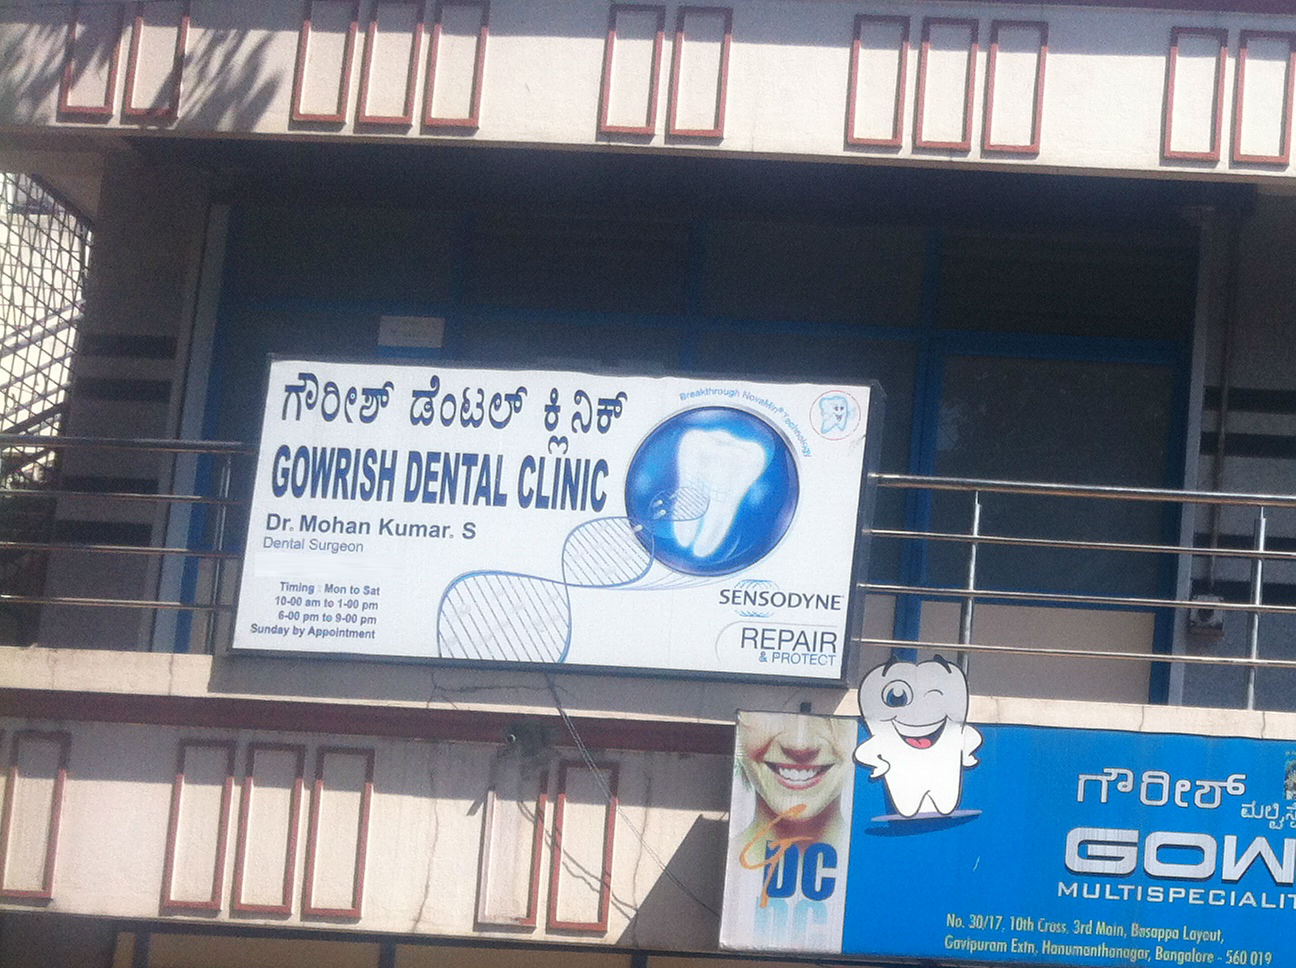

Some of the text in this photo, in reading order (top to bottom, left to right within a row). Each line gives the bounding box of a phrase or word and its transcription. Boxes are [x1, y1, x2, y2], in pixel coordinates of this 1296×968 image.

[679, 386, 741, 401] Breakthrough
[281, 373, 628, 454] ಗೌರೀಶ್ ಡೆಂಟಲ್ ಕ್ಲಿನಿಕ್
[272, 444, 609, 512] GOWRISH DENTAL CLINIC
[266, 513, 477, 540] Dr. Mohan Kumar. S
[263, 536, 364, 554] Dental Surgeon
[280, 581, 380, 596] Timing Mon to Sat
[719, 588, 842, 611] SENSODYNE
[275, 595, 378, 612] 10-00 am to 1-00 pm
[278, 610, 377, 626] 6-00 pm to 9-00 pm
[250, 623, 376, 640] Sunday by Appointment
[740, 626, 838, 654] REPAIR
[758, 652, 837, 666] & PROTECT
[1076, 767, 1247, 809] ಗೌರೀಶ್
[946, 913, 966, 929] No.
[1009, 915, 1034, 932] 10th
[1073, 919, 1093, 936] 3rd
[1095, 920, 1128, 939] Main,
[1131, 922, 1179, 943] Basappa
[1182, 925, 1225, 945] Layout,
[944, 934, 1008, 955] Gavipuram
[1041, 939, 1152, 963] Hanumanthanagar,
[1154, 945, 1215, 966] Bangalore
[1225, 949, 1248, 966] 560
[1250, 950, 1273, 967] 019
